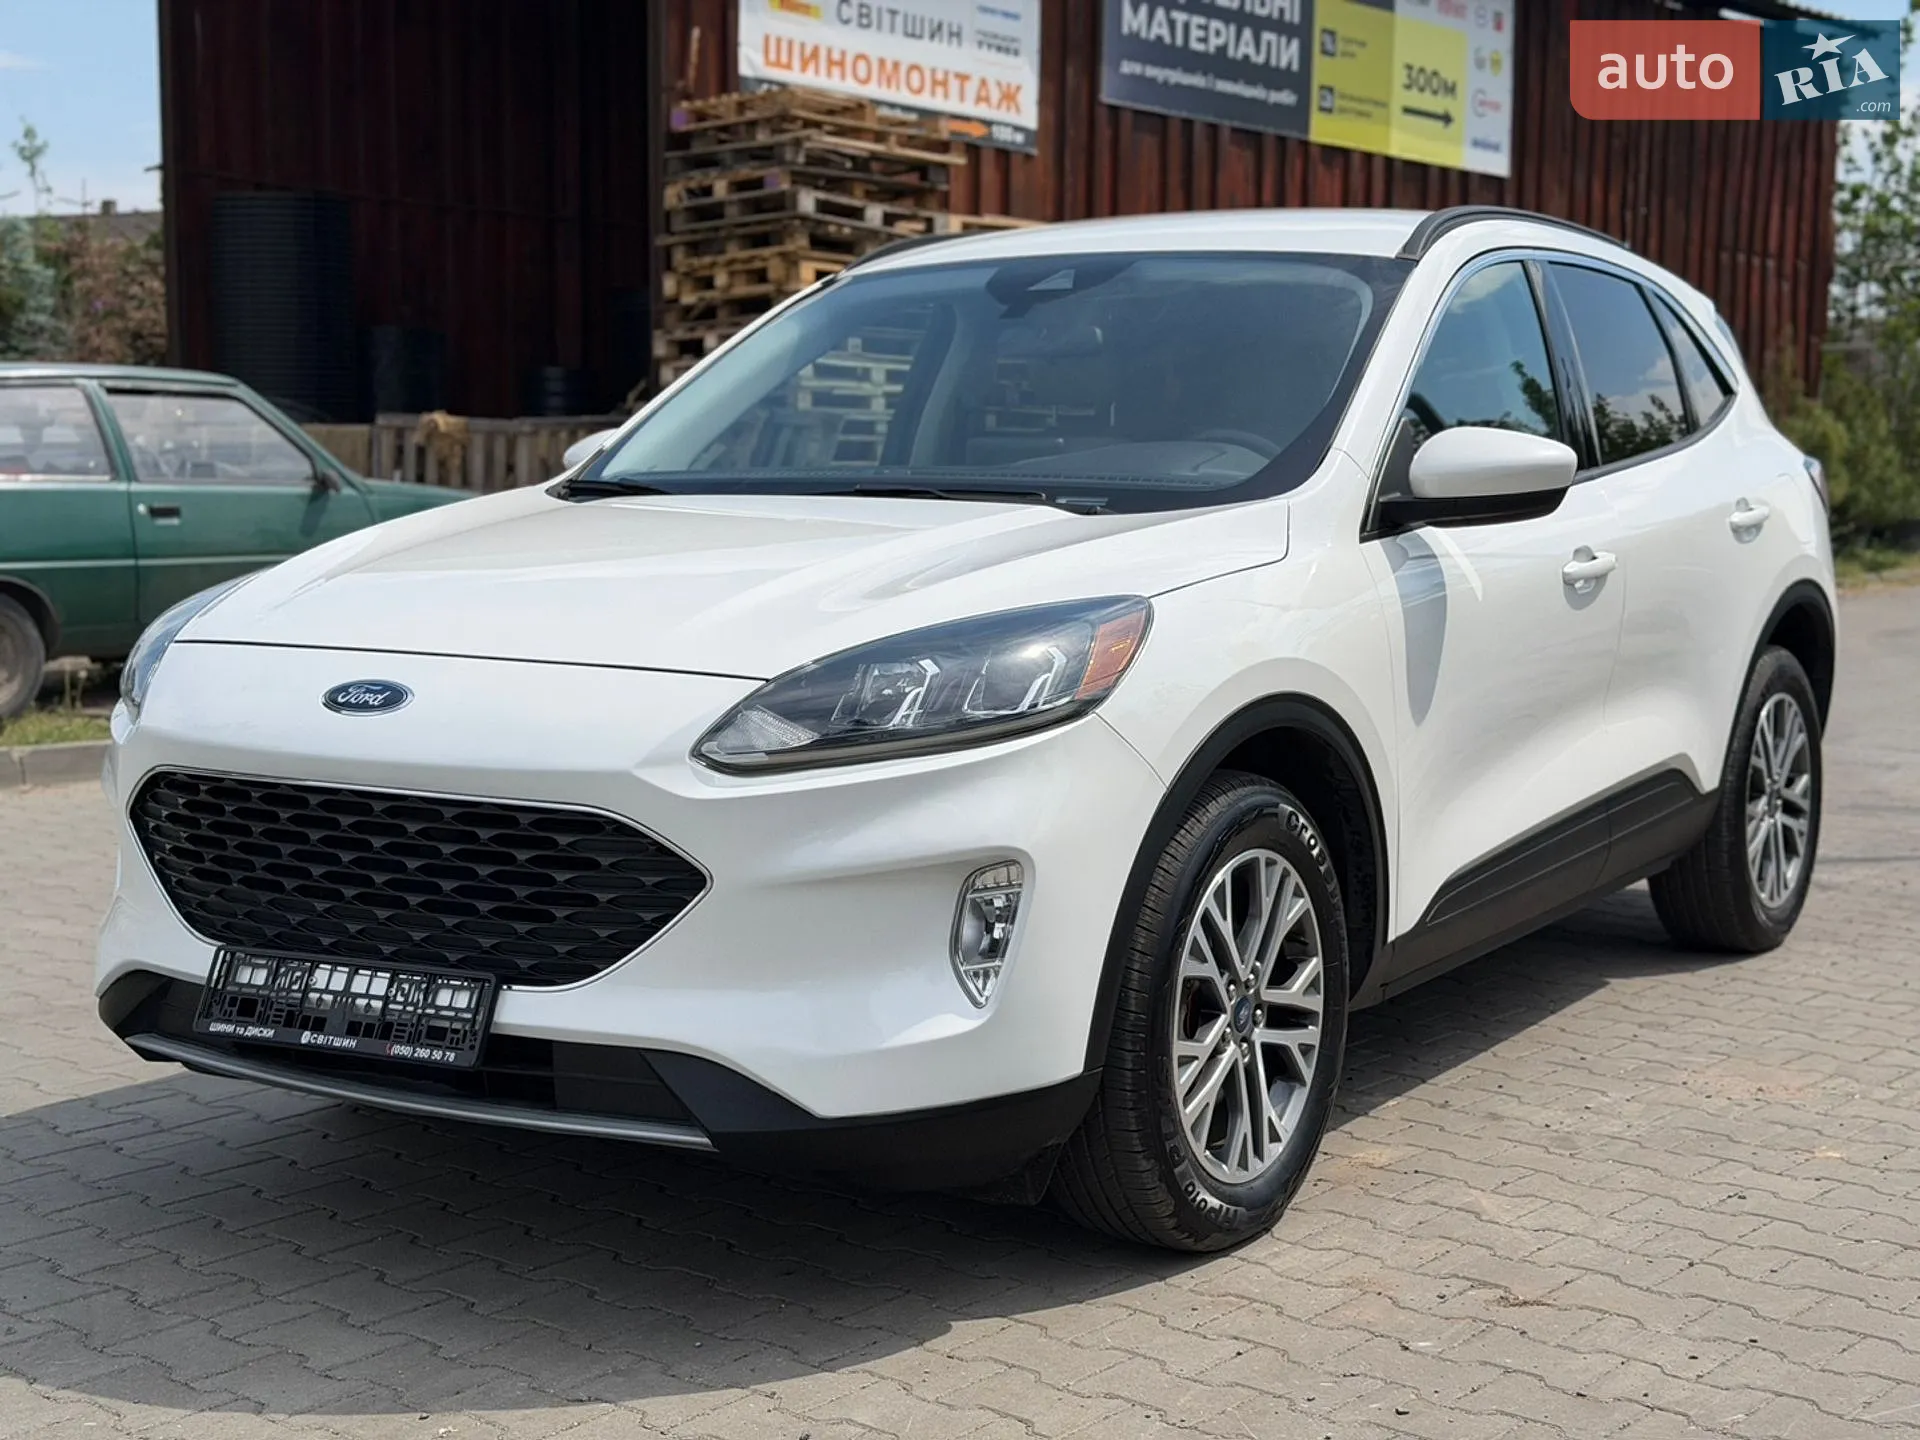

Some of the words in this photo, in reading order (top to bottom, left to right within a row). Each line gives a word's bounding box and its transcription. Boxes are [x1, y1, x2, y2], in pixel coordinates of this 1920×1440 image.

[836, 0, 963, 46] СВІТШИН
[1121, 1, 1300, 73] МАТЕРІАЛИ
[763, 33, 1022, 115] ШИНОМОНТАЖ
[337, 683, 393, 706] Ford
[243, 1025, 276, 1038] ДИСКИ
[310, 1034, 358, 1049] СВІТШИН
